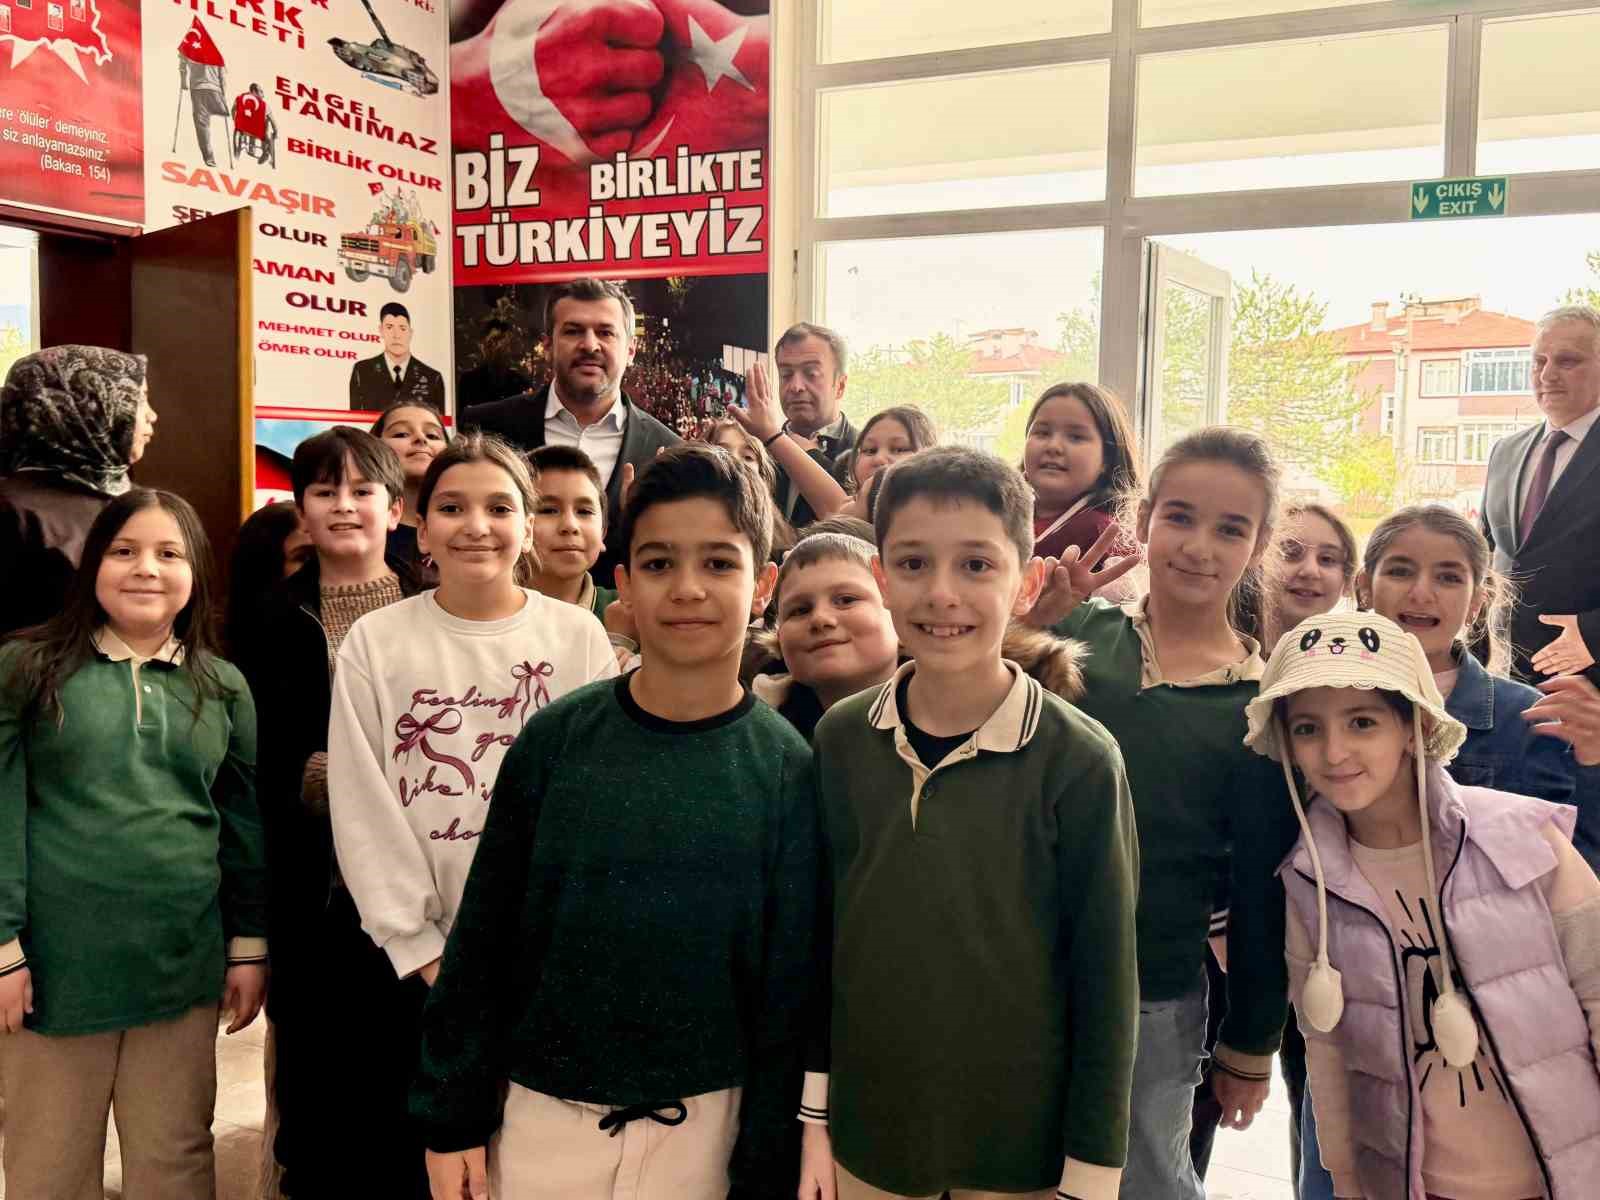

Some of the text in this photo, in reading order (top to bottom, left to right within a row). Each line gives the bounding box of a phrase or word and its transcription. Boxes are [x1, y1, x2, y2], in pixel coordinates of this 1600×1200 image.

[275, 76, 382, 122] ENGEL
[2, 128, 19, 143] siz
[275, 91, 438, 156] TANIMAZ
[88, 165, 111, 185] 154)
[287, 138, 443, 192] BİRLİK OLUR
[455, 133, 763, 210] BİZ BİRLİKTE
[161, 161, 336, 218] SAVAŞIR
[1436, 182, 1482, 200] ÇIKIŞ
[1439, 201, 1477, 215] EXIT
[259, 223, 328, 247] OLUR
[456, 196, 764, 267] TÜRKİYEYİZ
[285, 292, 368, 317] OLUR
[258, 320, 381, 343] MEHMET OLUR
[258, 339, 358, 360] ÖMER OLUR
[410, 685, 521, 719] Feeling
